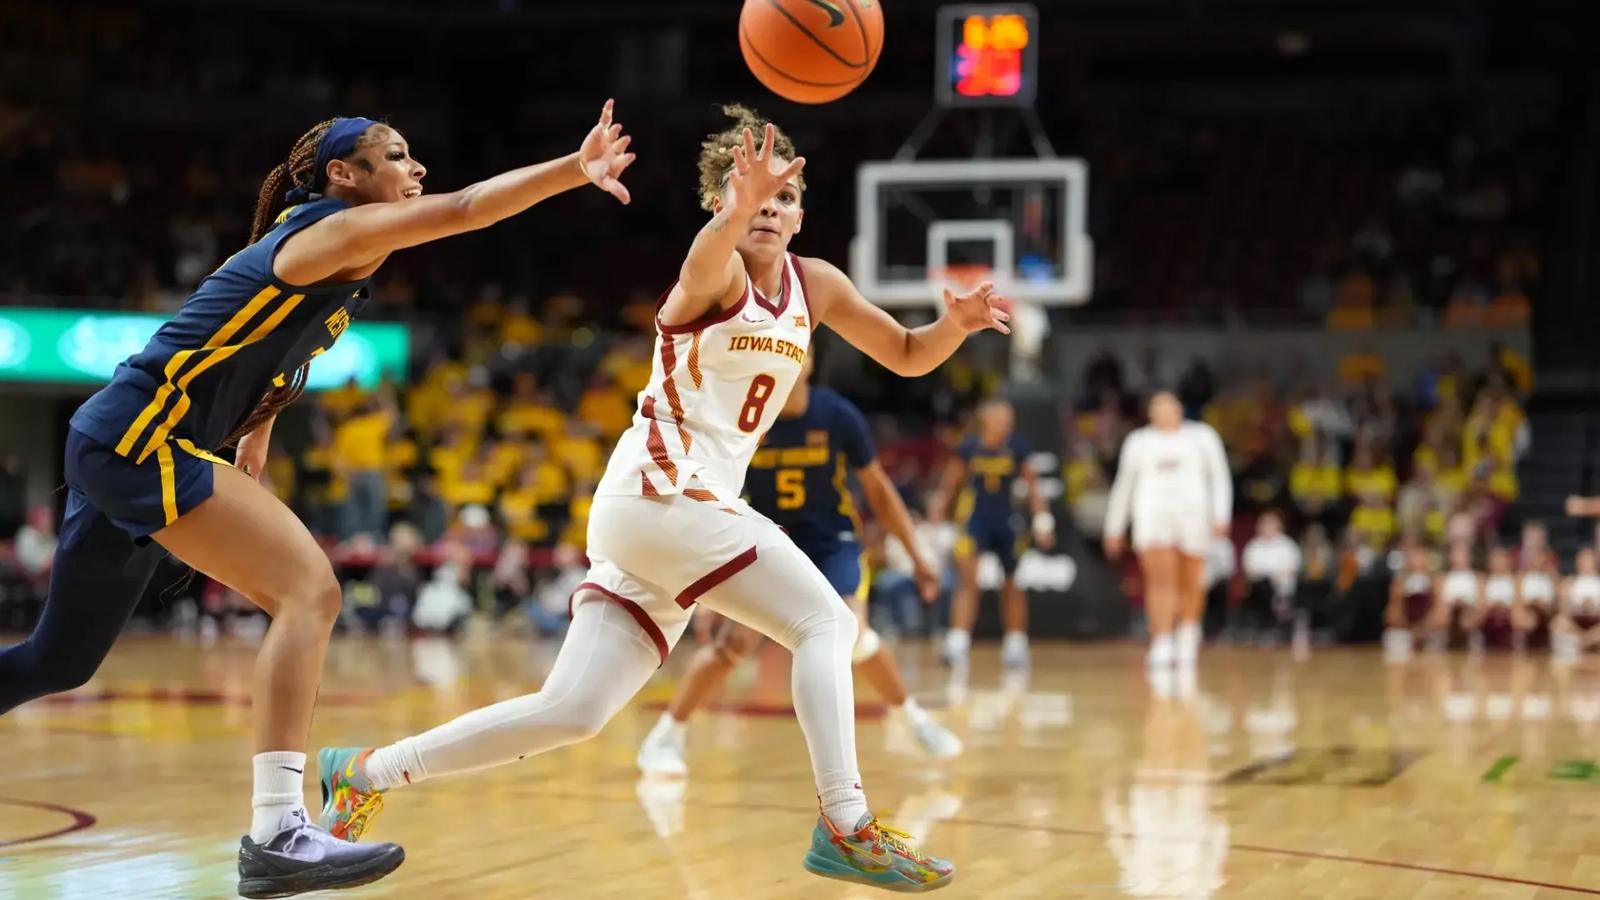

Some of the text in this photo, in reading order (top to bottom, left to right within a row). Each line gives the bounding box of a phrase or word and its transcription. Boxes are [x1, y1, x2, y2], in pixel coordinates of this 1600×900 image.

[727, 335, 805, 364] IOWA STAT
[737, 373, 776, 433] 8
[775, 468, 806, 510] 5
